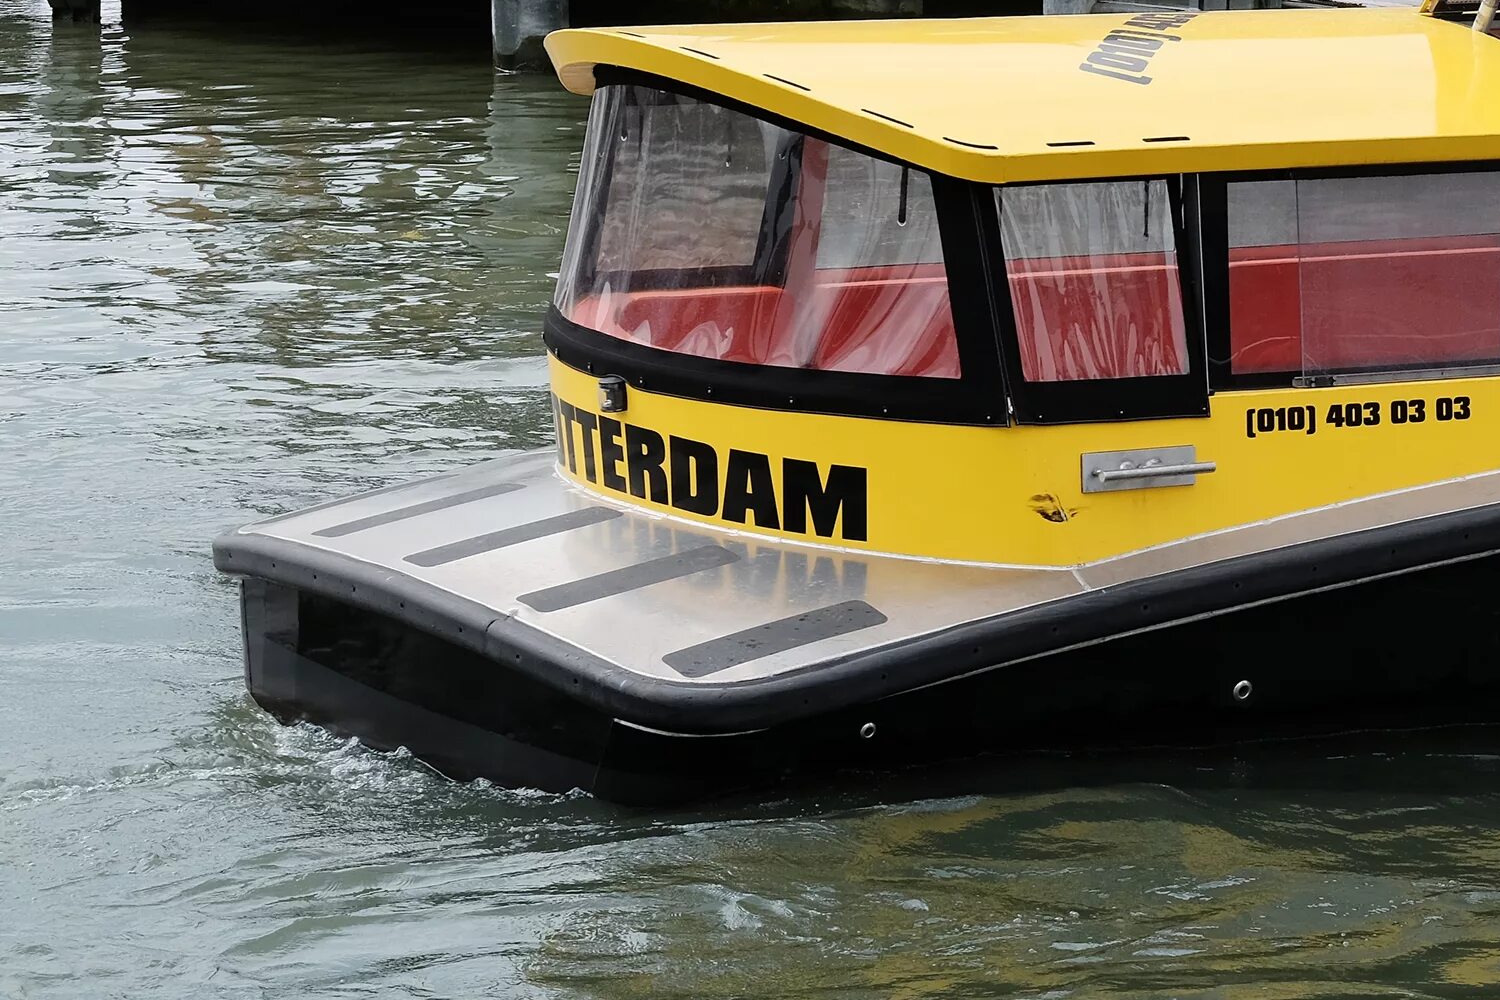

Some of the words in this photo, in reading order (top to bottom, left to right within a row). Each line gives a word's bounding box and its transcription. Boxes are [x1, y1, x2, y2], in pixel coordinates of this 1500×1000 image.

[1326, 402, 1381, 428] 403
[1390, 399, 1426, 424] 03
[1436, 396, 1471, 421] 03
